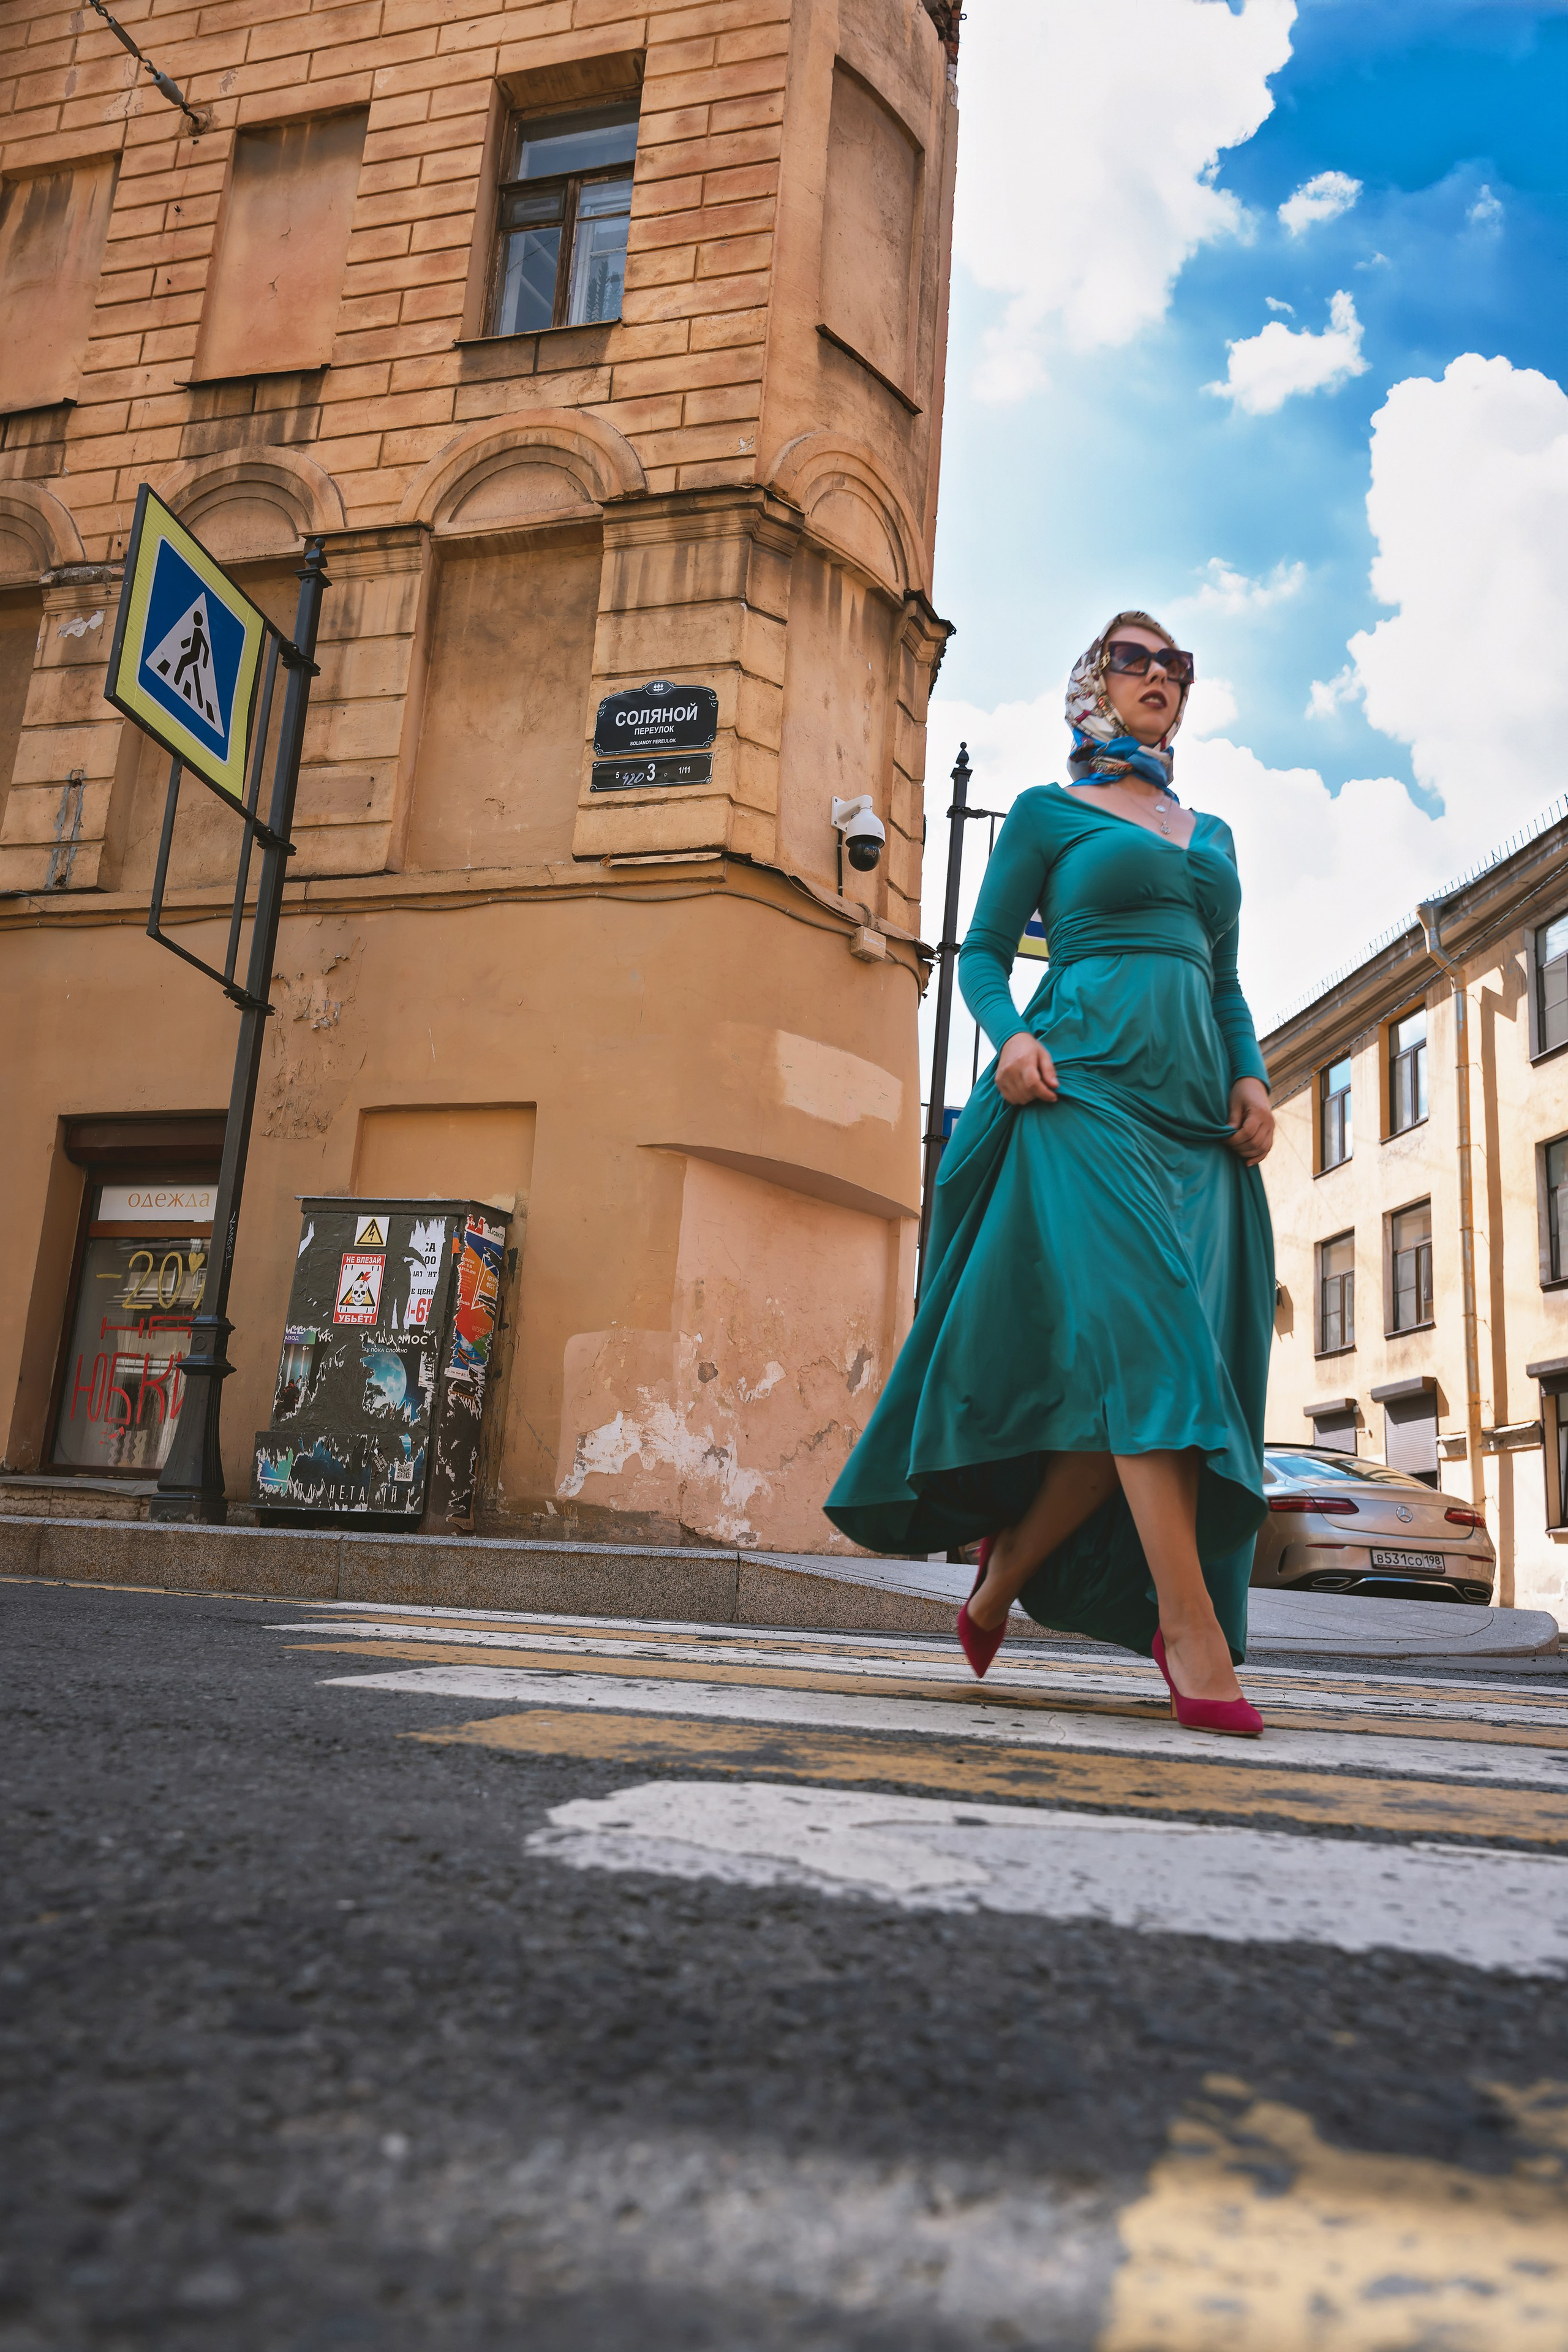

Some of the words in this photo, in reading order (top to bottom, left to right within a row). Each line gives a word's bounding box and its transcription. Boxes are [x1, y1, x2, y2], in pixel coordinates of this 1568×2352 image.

[616, 703, 698, 726] СОЛЯНОЙ
[634, 725, 674, 736] ПЕРЕУЛОК
[646, 763, 656, 781] 3
[128, 1193, 210, 1207] одежда
[356, 1256, 382, 1264] ВЛЕЗАЙ
[338, 1314, 372, 1323] УБЬЁТ!
[1424, 1555, 1441, 1565] 198
